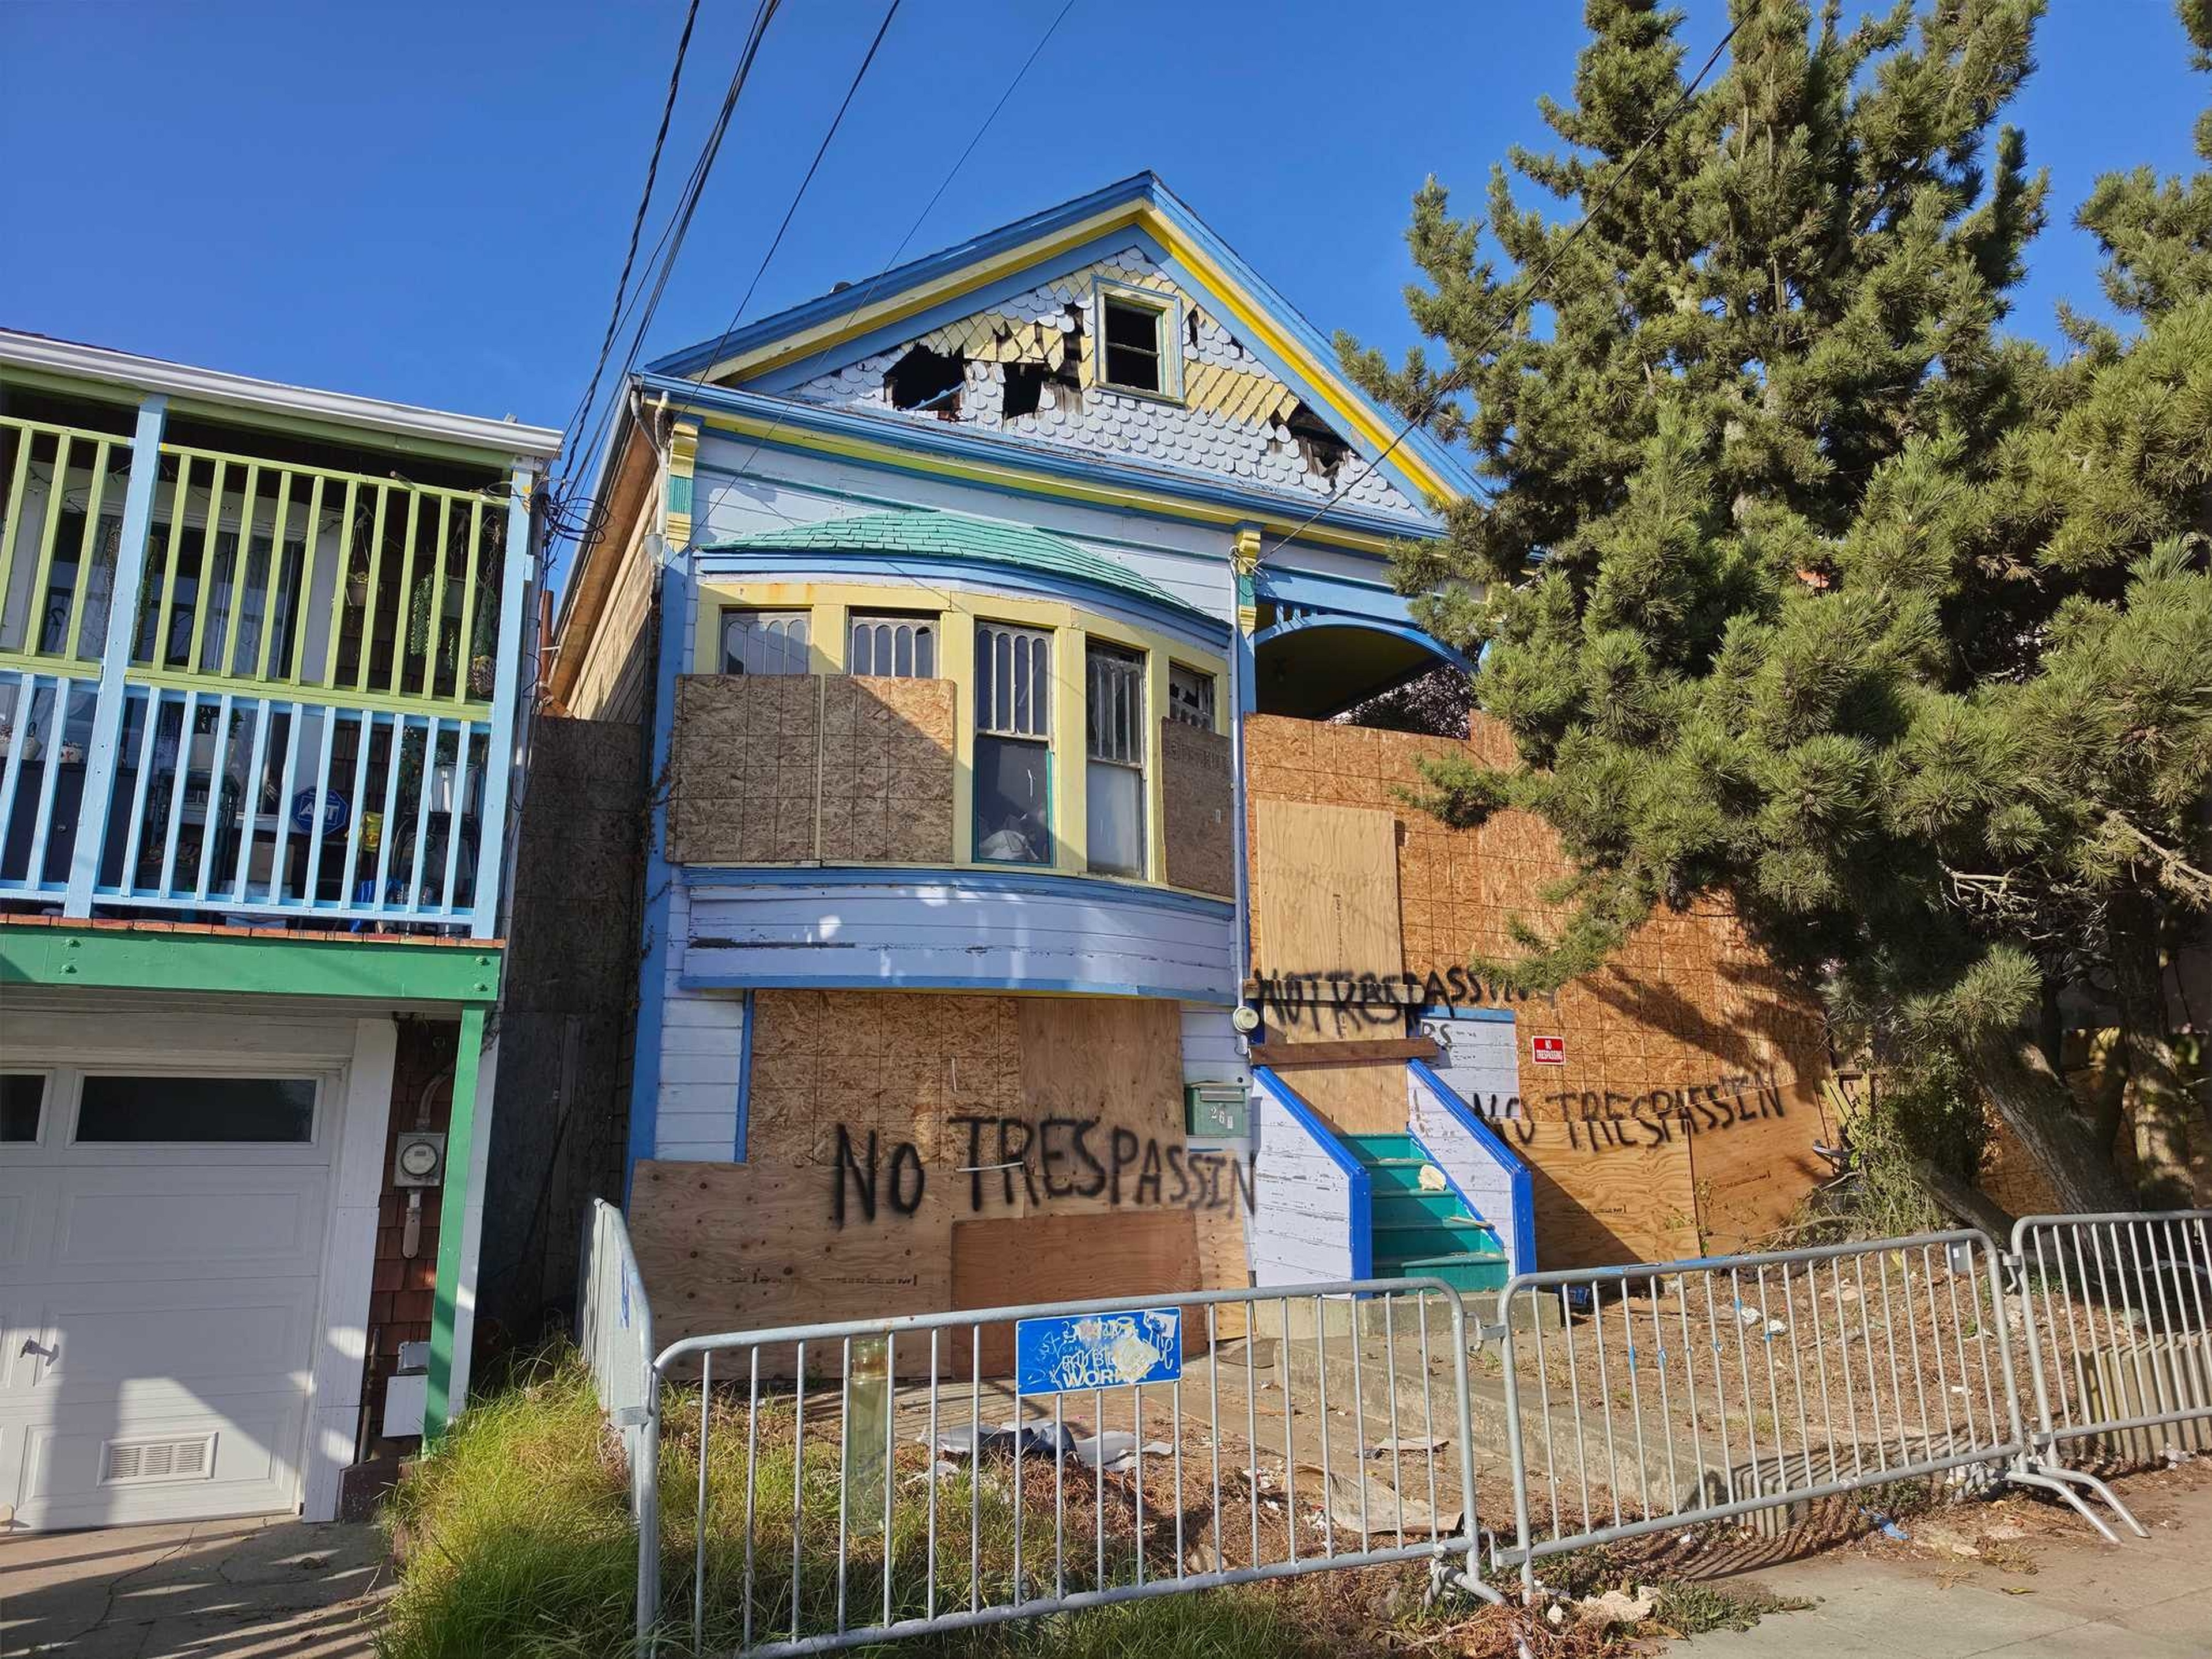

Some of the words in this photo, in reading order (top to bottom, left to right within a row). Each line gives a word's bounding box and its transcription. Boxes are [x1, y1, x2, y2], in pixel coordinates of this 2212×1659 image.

[300, 801, 339, 820] AT
[1545, 1039, 1552, 1050] NO
[1473, 1093, 1536, 1145] NO
[833, 1122, 925, 1230] NO
[948, 1115, 1257, 1219] TRESPASSIN
